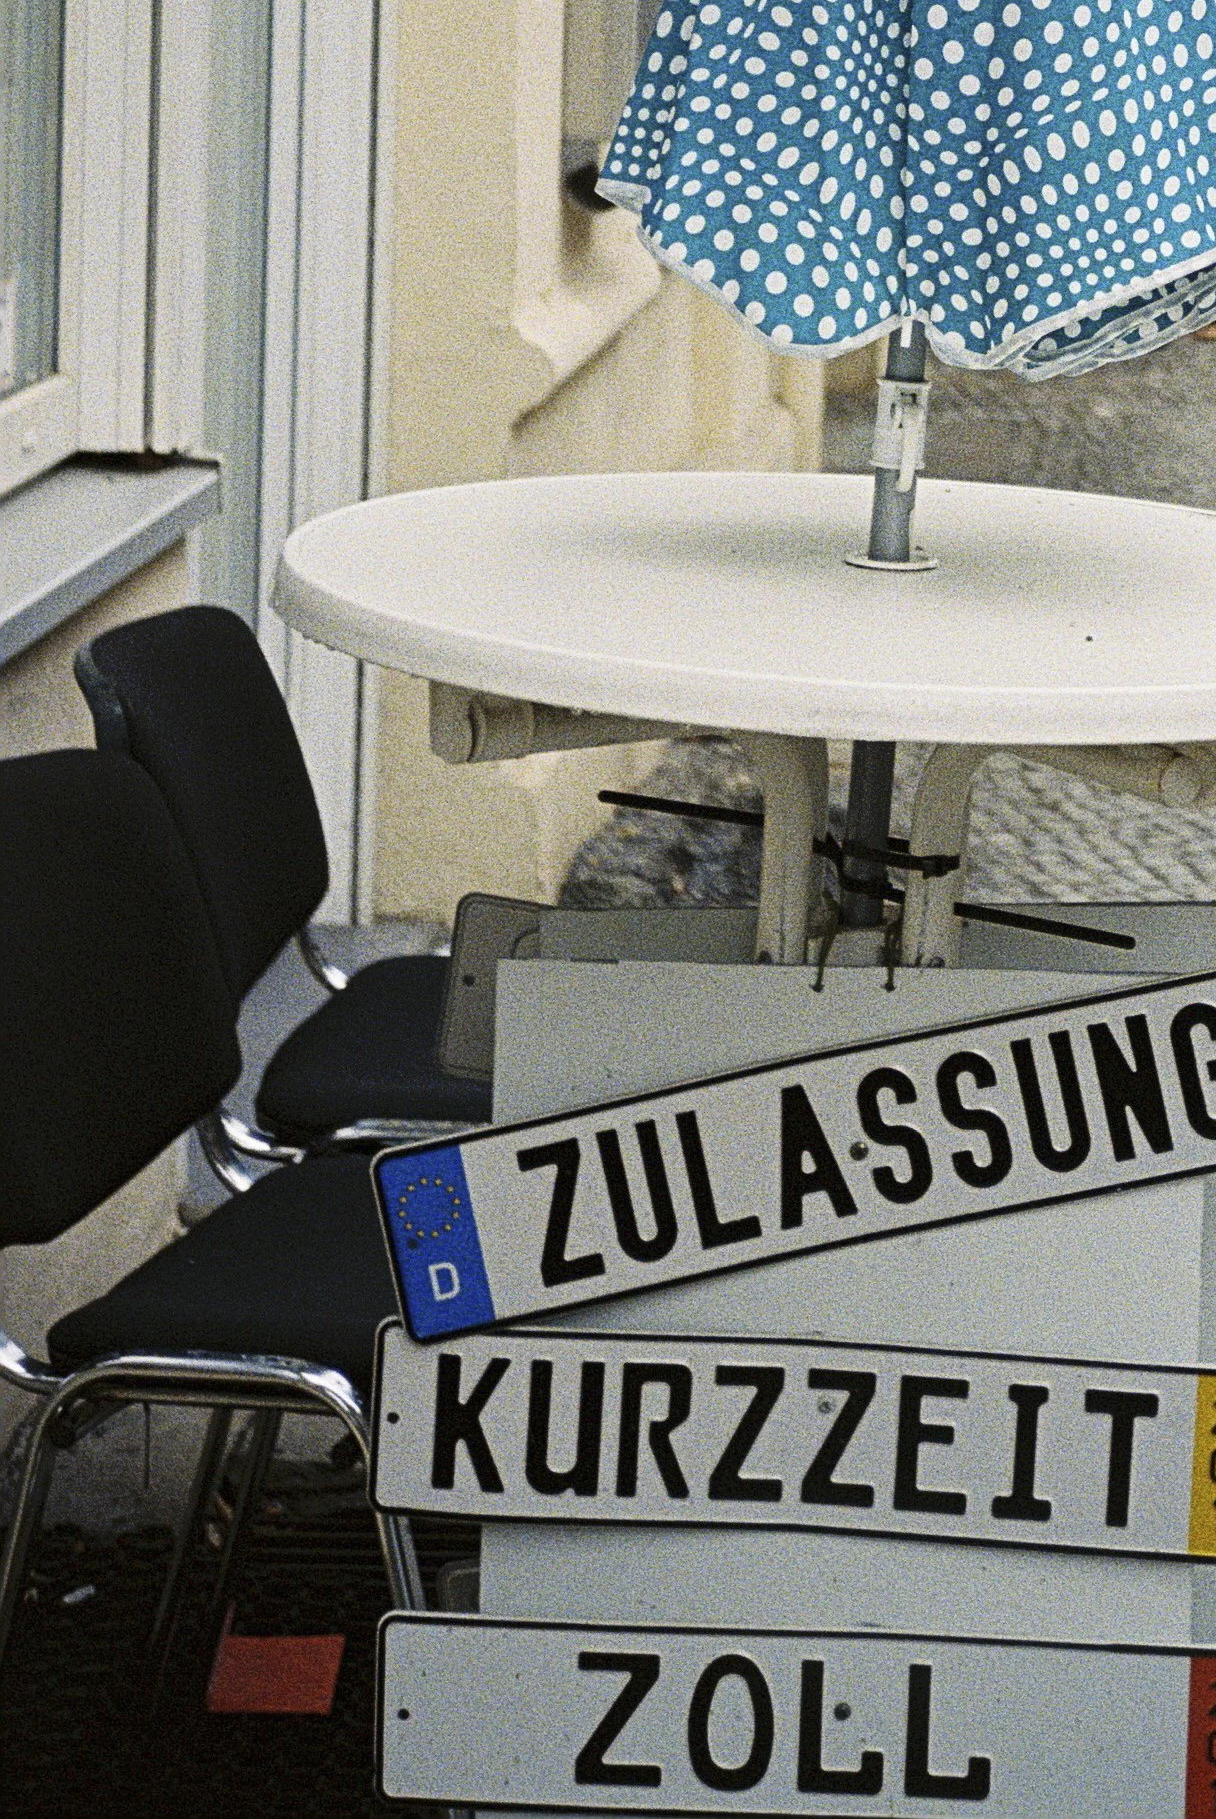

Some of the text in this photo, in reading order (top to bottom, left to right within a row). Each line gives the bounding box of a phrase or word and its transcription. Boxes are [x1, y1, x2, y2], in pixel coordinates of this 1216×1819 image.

[428, 1262, 460, 1301] D
[430, 1352, 1160, 1528] KURZZEIT
[574, 1651, 991, 1802] ZOLL
